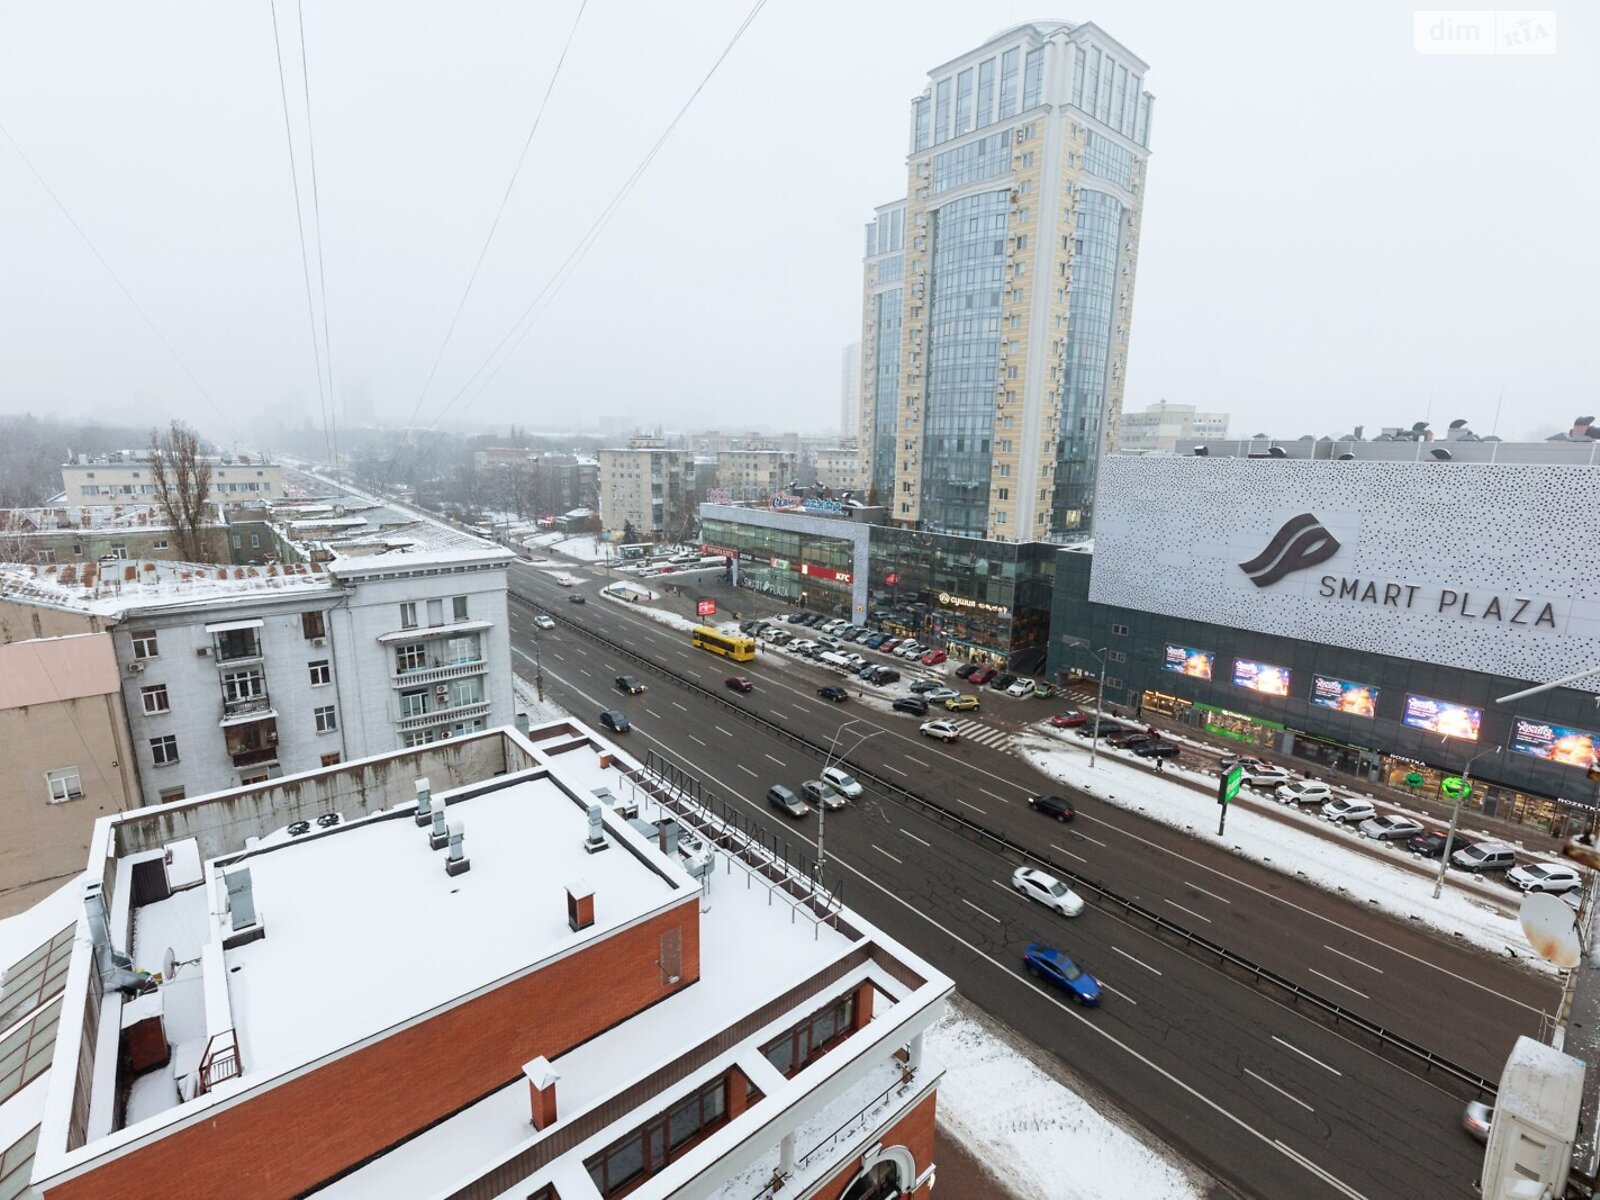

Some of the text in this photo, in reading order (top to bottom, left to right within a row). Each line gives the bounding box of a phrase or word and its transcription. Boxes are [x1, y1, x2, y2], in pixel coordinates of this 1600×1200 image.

[835, 572, 851, 582] KFC
[1319, 575, 1556, 628] SMART PLAZA
